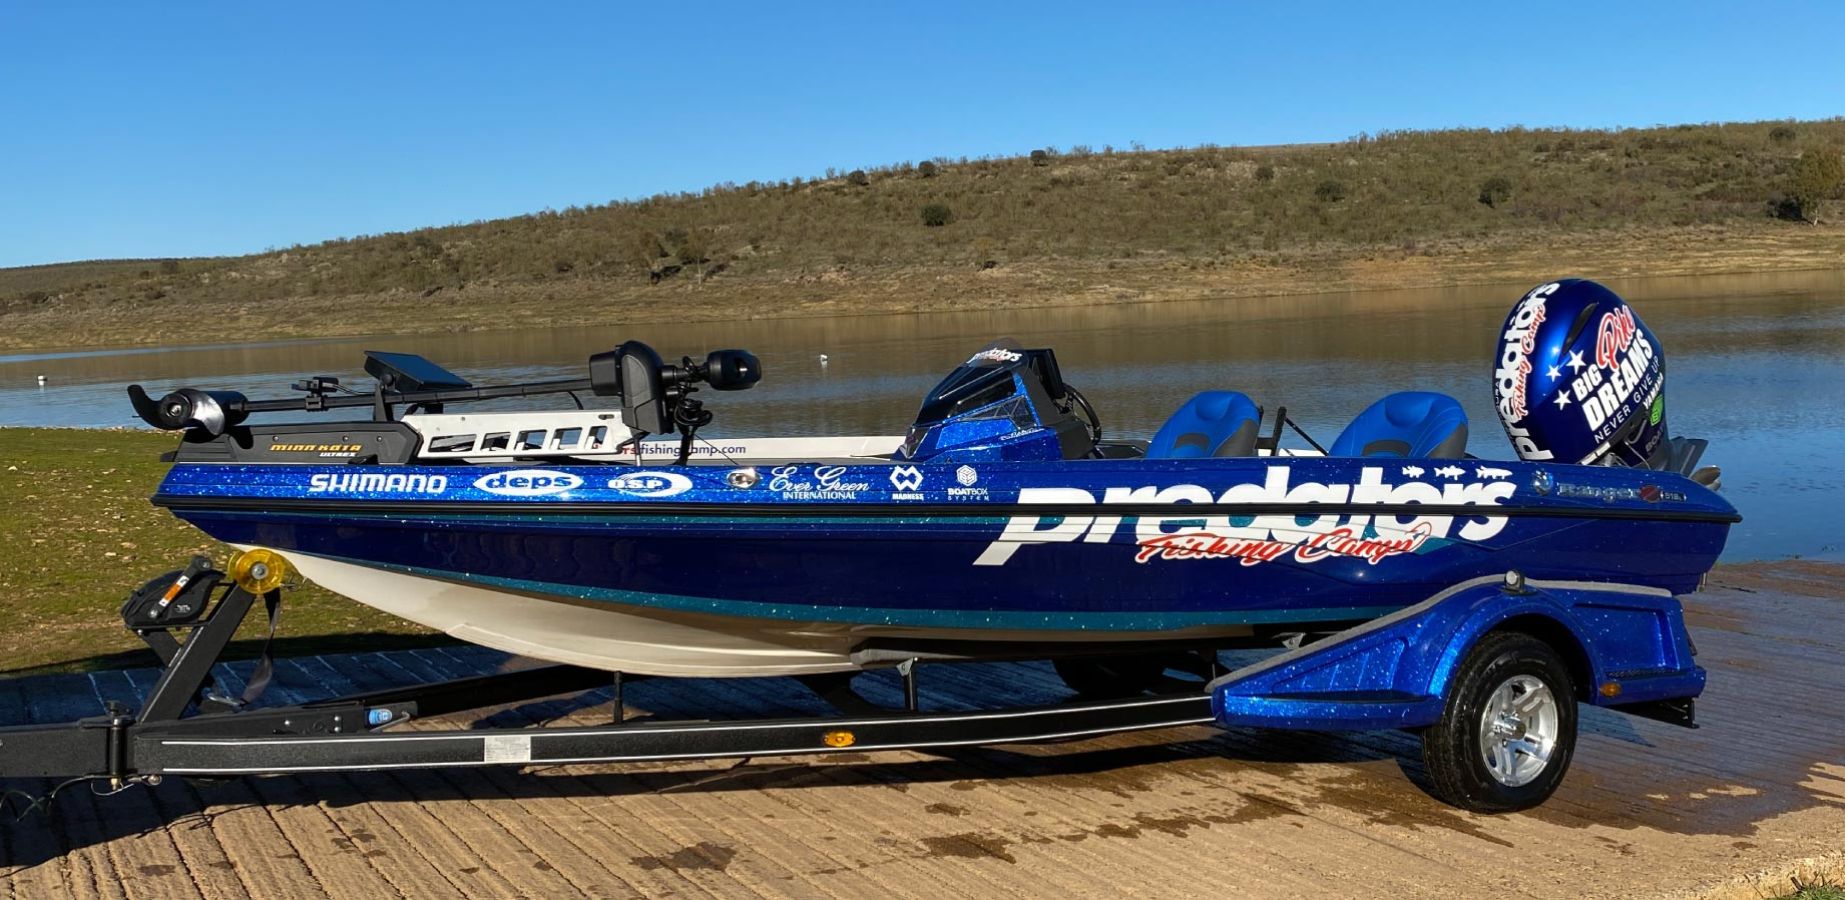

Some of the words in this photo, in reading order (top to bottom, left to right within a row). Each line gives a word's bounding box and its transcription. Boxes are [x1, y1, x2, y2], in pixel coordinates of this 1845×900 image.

[1521, 303, 1547, 355] Camp
[1496, 282, 1560, 461] predators
[1571, 363, 1603, 401] BIG
[1582, 328, 1653, 432] DREAMS
[1594, 404, 1632, 444] NEVER
[1633, 373, 1653, 404] GIVE
[1651, 355, 1661, 374] UP
[270, 444, 317, 452] MINN
[318, 444, 362, 452] KOTA
[309, 473, 448, 494] SHIMANO
[485, 474, 573, 491] deps
[769, 466, 813, 491] Ever
[814, 466, 869, 491] Green
[783, 491, 857, 500] INTERNATIONAL
[947, 488, 989, 496] BOATBOX
[973, 466, 1518, 566] predators
[1294, 522, 1432, 564] Camp
